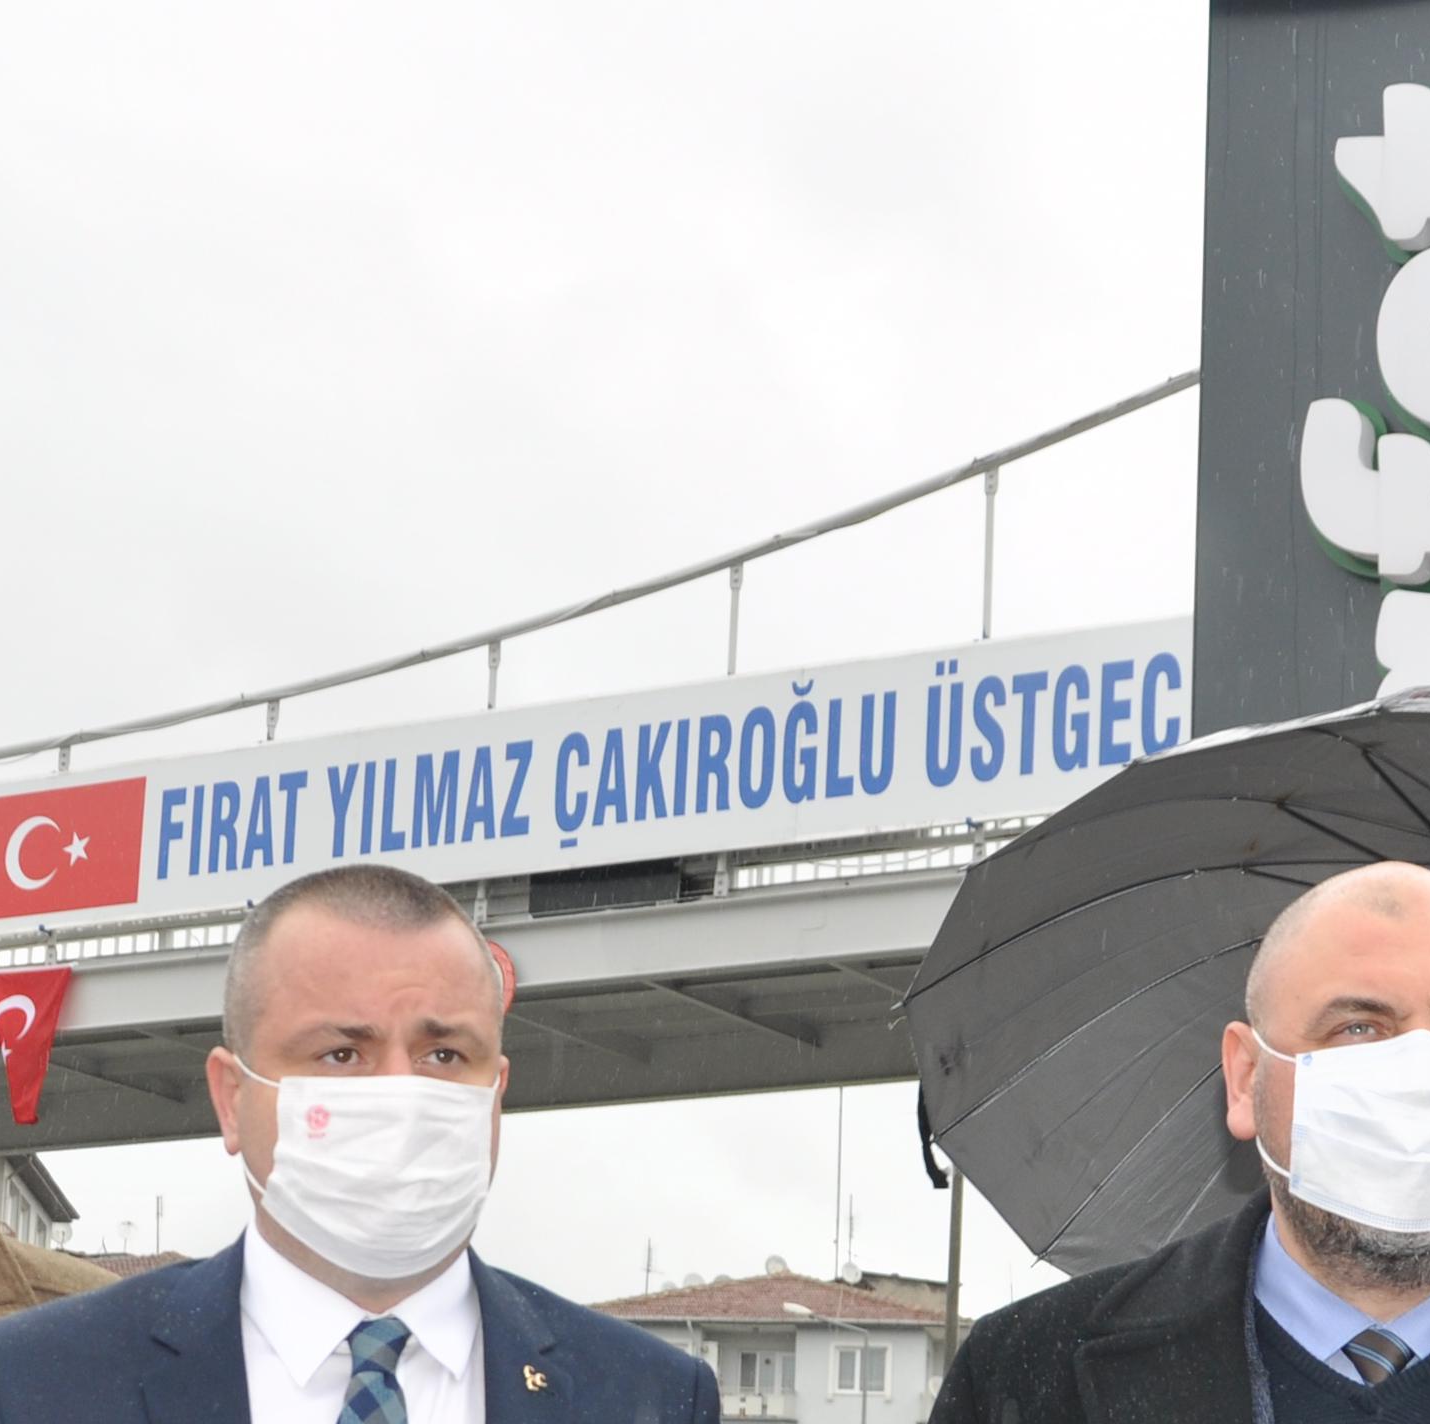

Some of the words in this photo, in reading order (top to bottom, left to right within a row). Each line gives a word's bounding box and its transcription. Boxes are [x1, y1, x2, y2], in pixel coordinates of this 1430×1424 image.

[156, 770, 309, 881] FIRAT
[327, 740, 534, 858] YILMAZ
[554, 681, 897, 849] ÇAKIROĞLU
